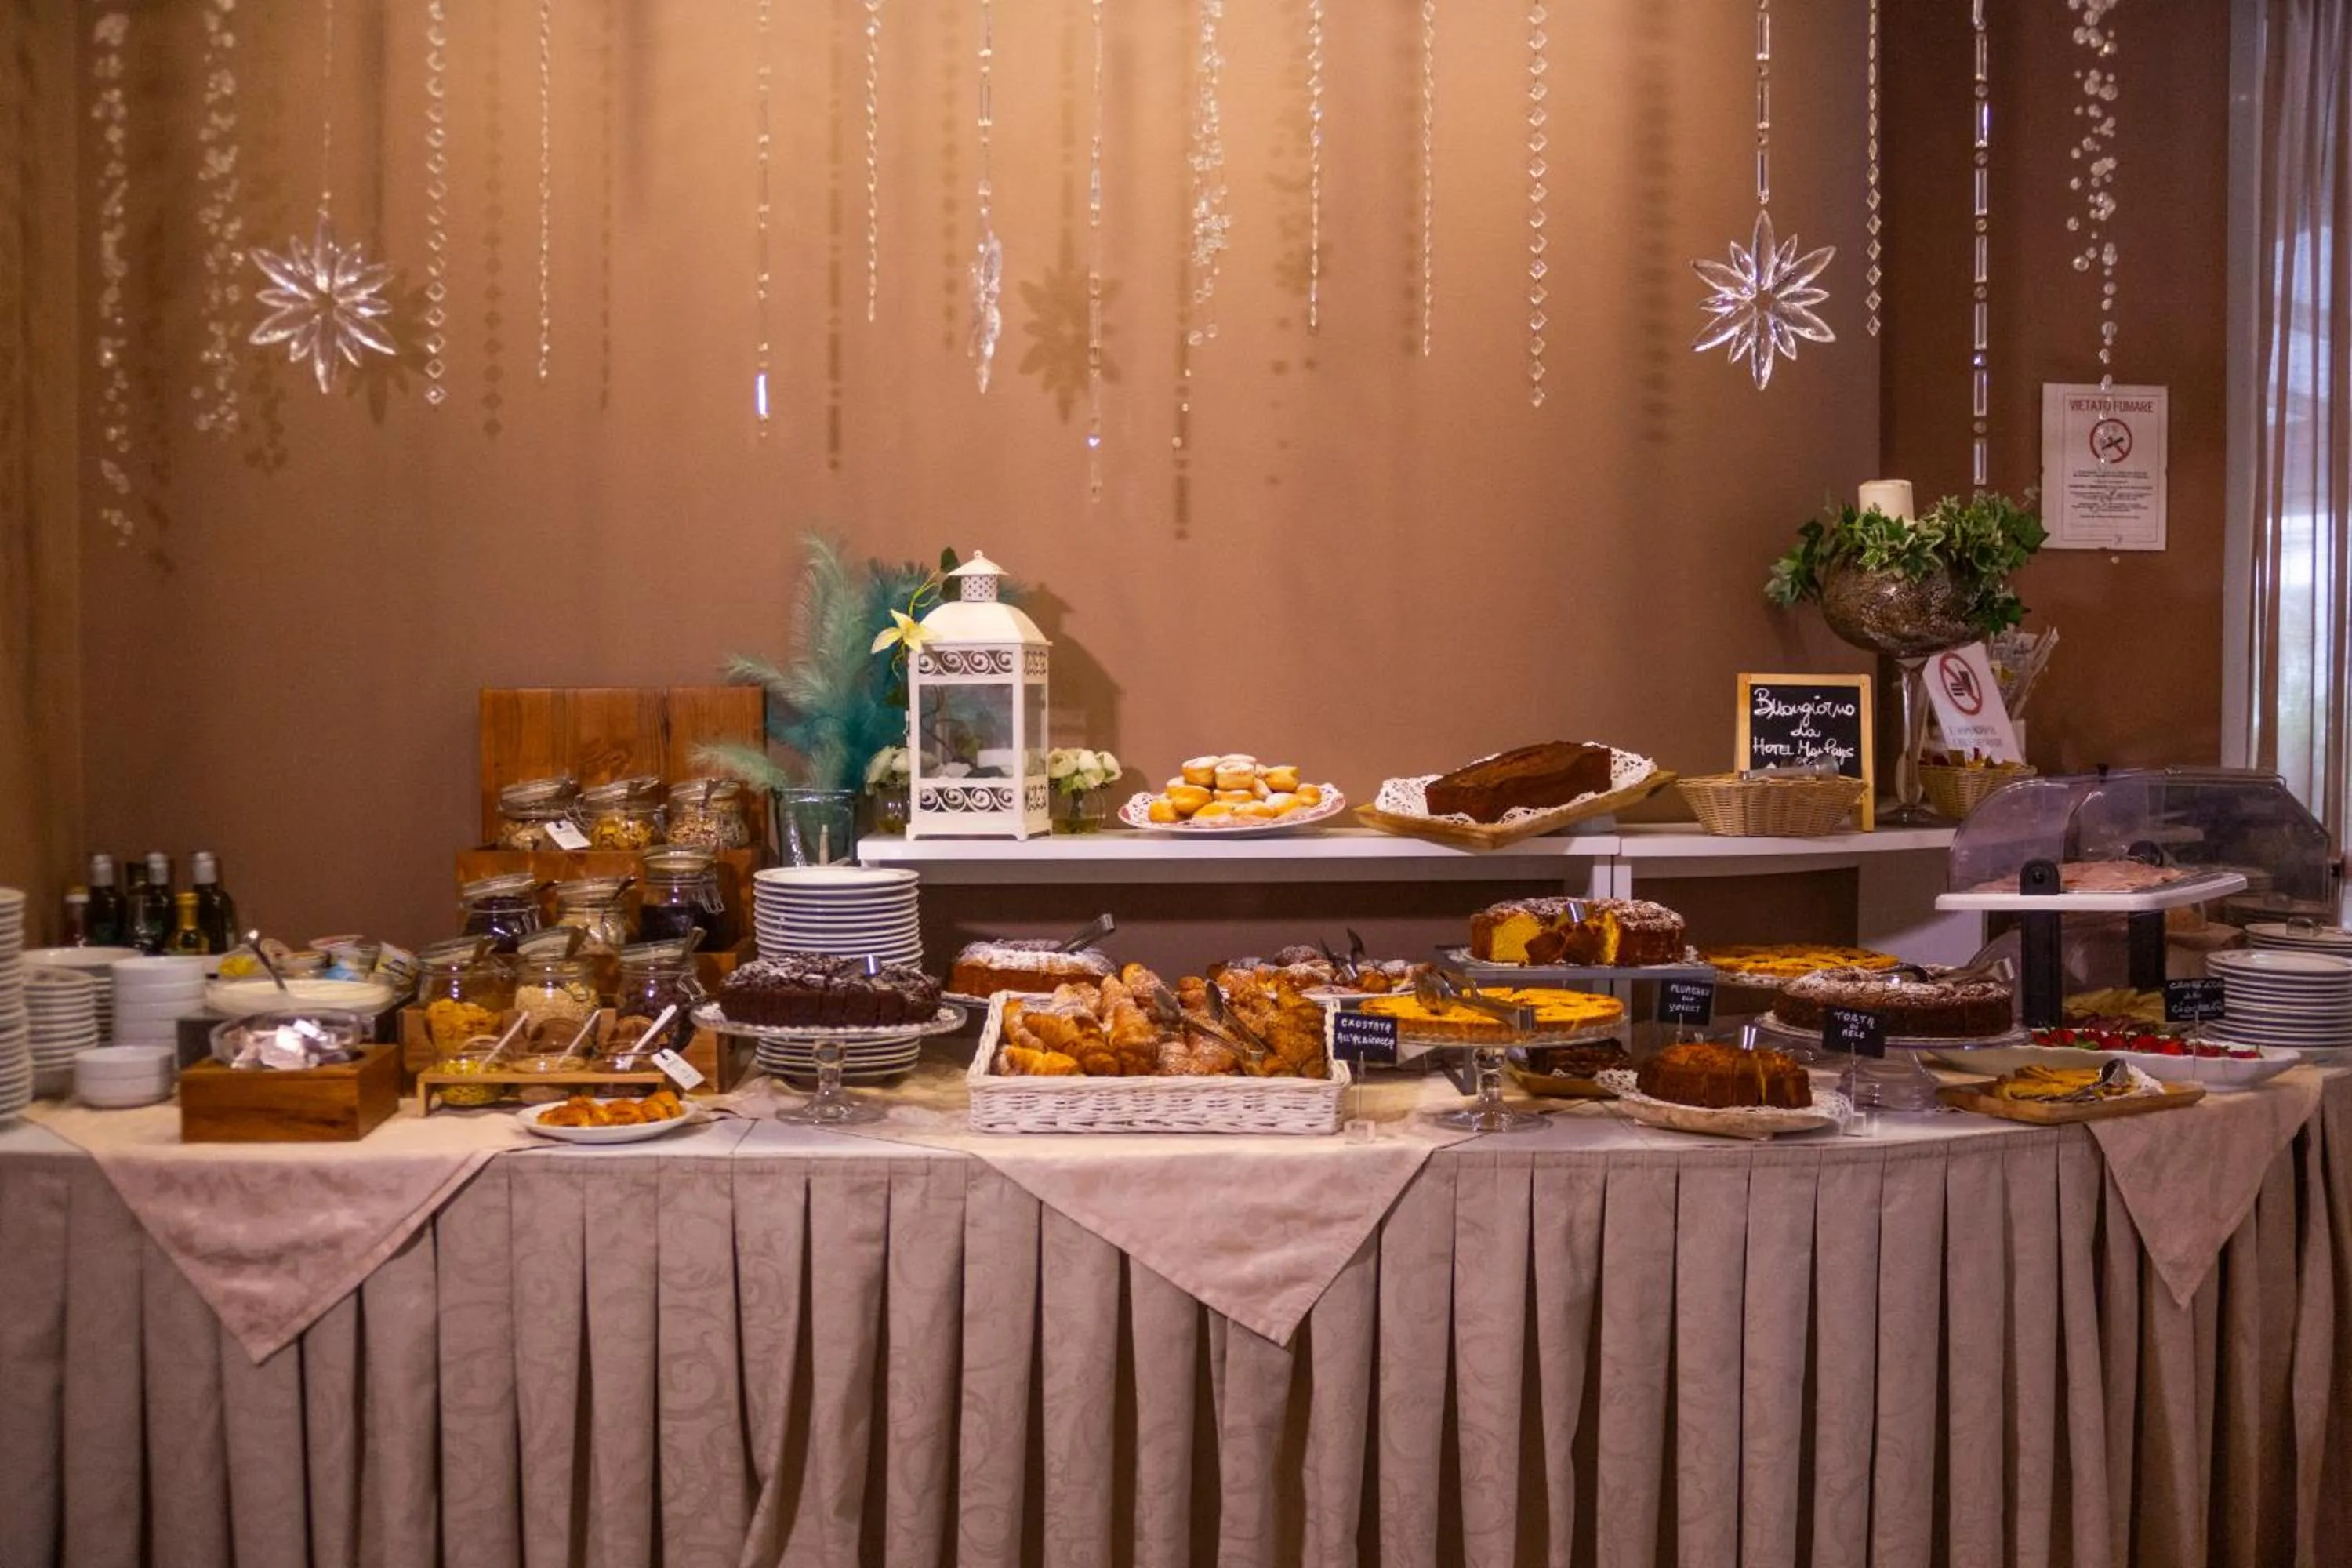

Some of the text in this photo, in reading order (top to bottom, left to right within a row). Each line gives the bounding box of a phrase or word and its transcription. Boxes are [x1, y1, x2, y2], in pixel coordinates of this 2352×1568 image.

[2069, 400, 2154, 413] VIETATO FUMARE
[1754, 688, 1856, 727] Buongiorno
[1790, 722, 1821, 738] da
[1341, 1018, 1392, 1034] CROSTATA
[1834, 1011, 1875, 1029] TORTA
